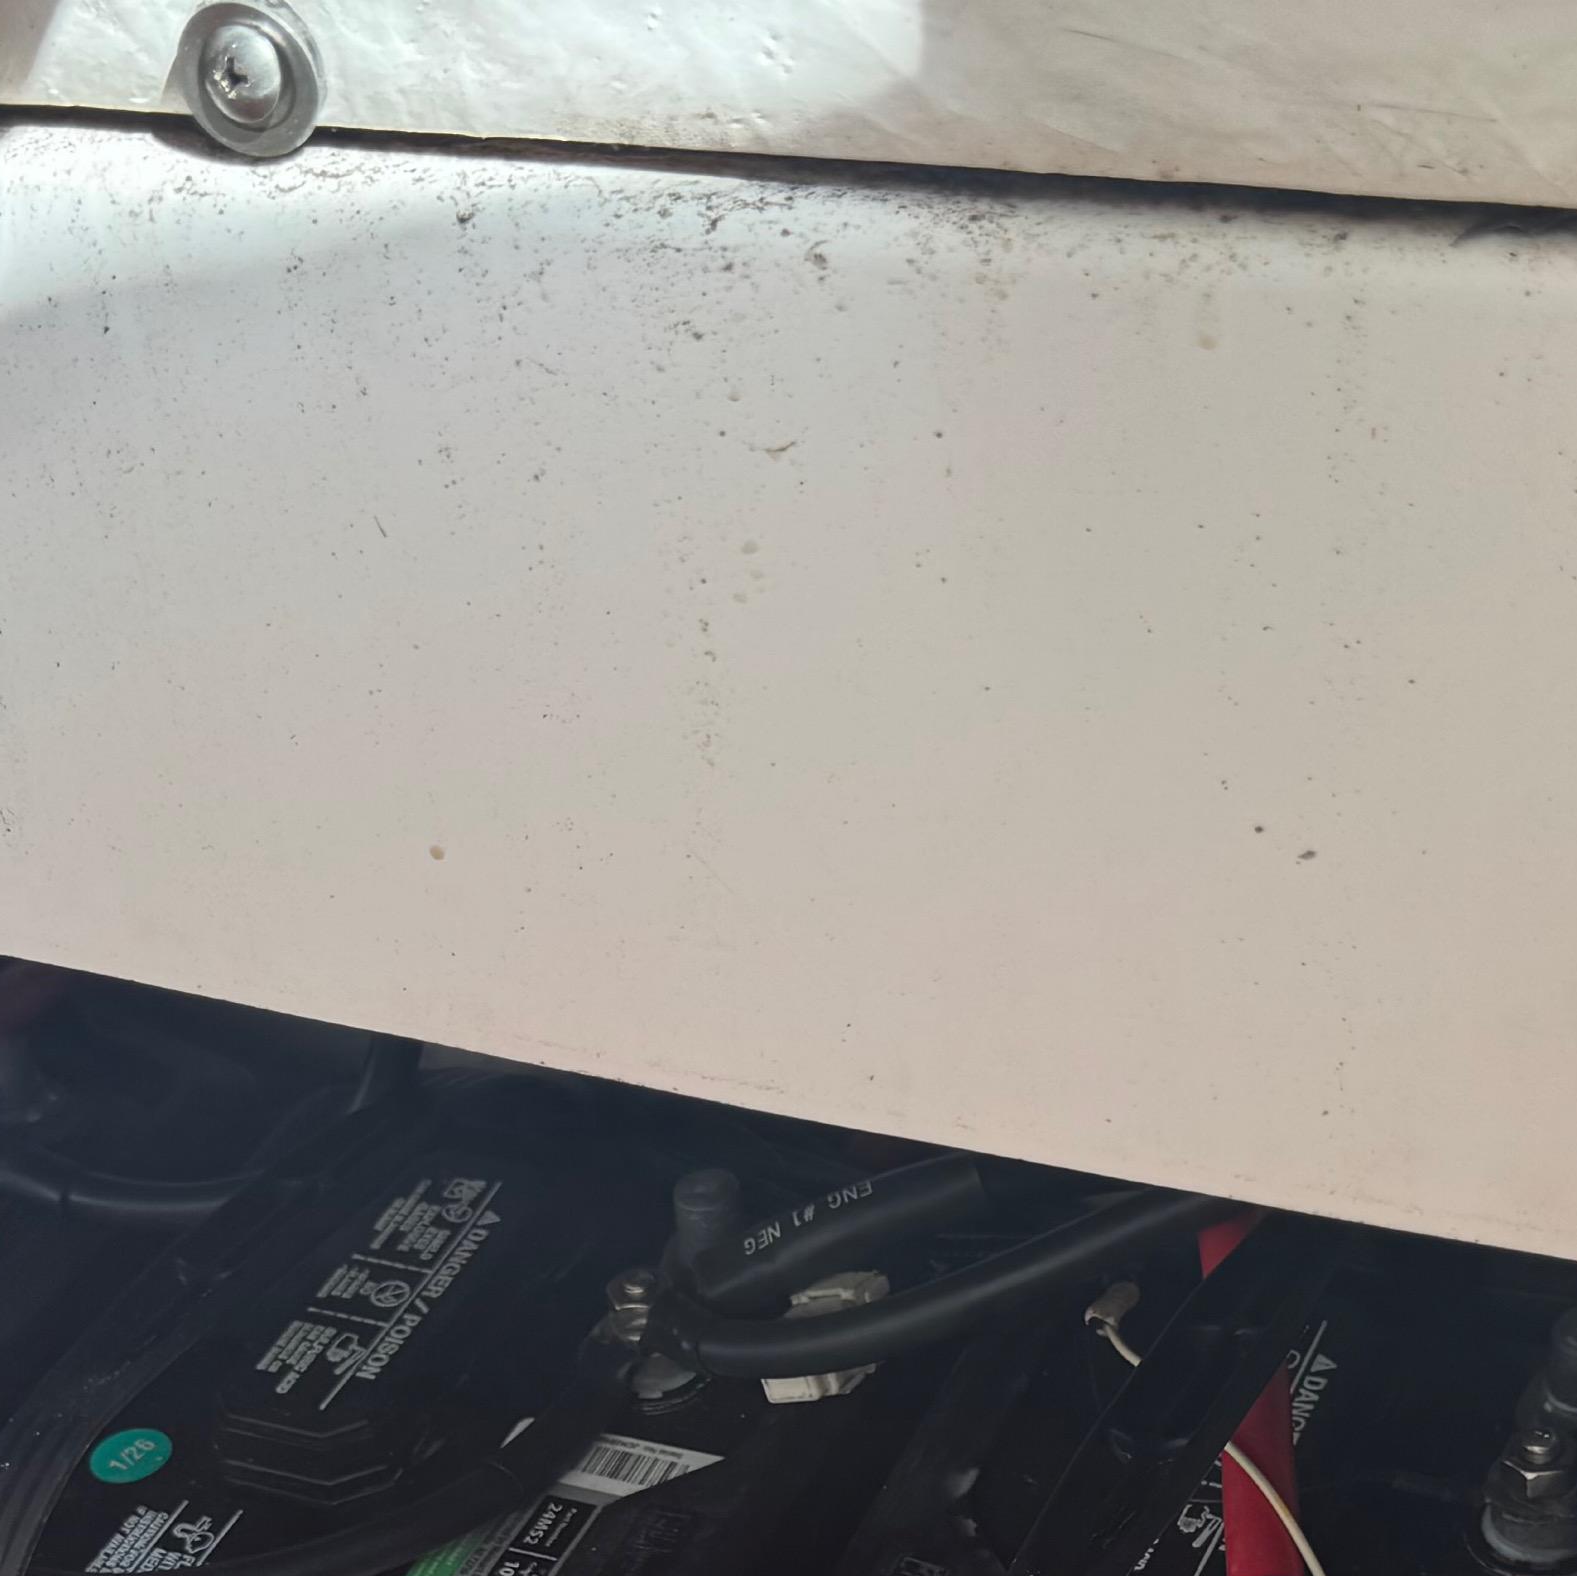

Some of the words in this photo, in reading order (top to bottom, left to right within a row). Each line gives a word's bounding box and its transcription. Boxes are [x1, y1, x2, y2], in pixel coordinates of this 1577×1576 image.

[827, 1179, 873, 1208] ENG
[791, 1202, 814, 1226] #1
[743, 1220, 782, 1254] NEG
[418, 1228, 490, 1298] DANGER
[352, 1312, 424, 1380] POISON
[108, 1441, 155, 1470] 1/26
[521, 1502, 565, 1544] 24MS2
